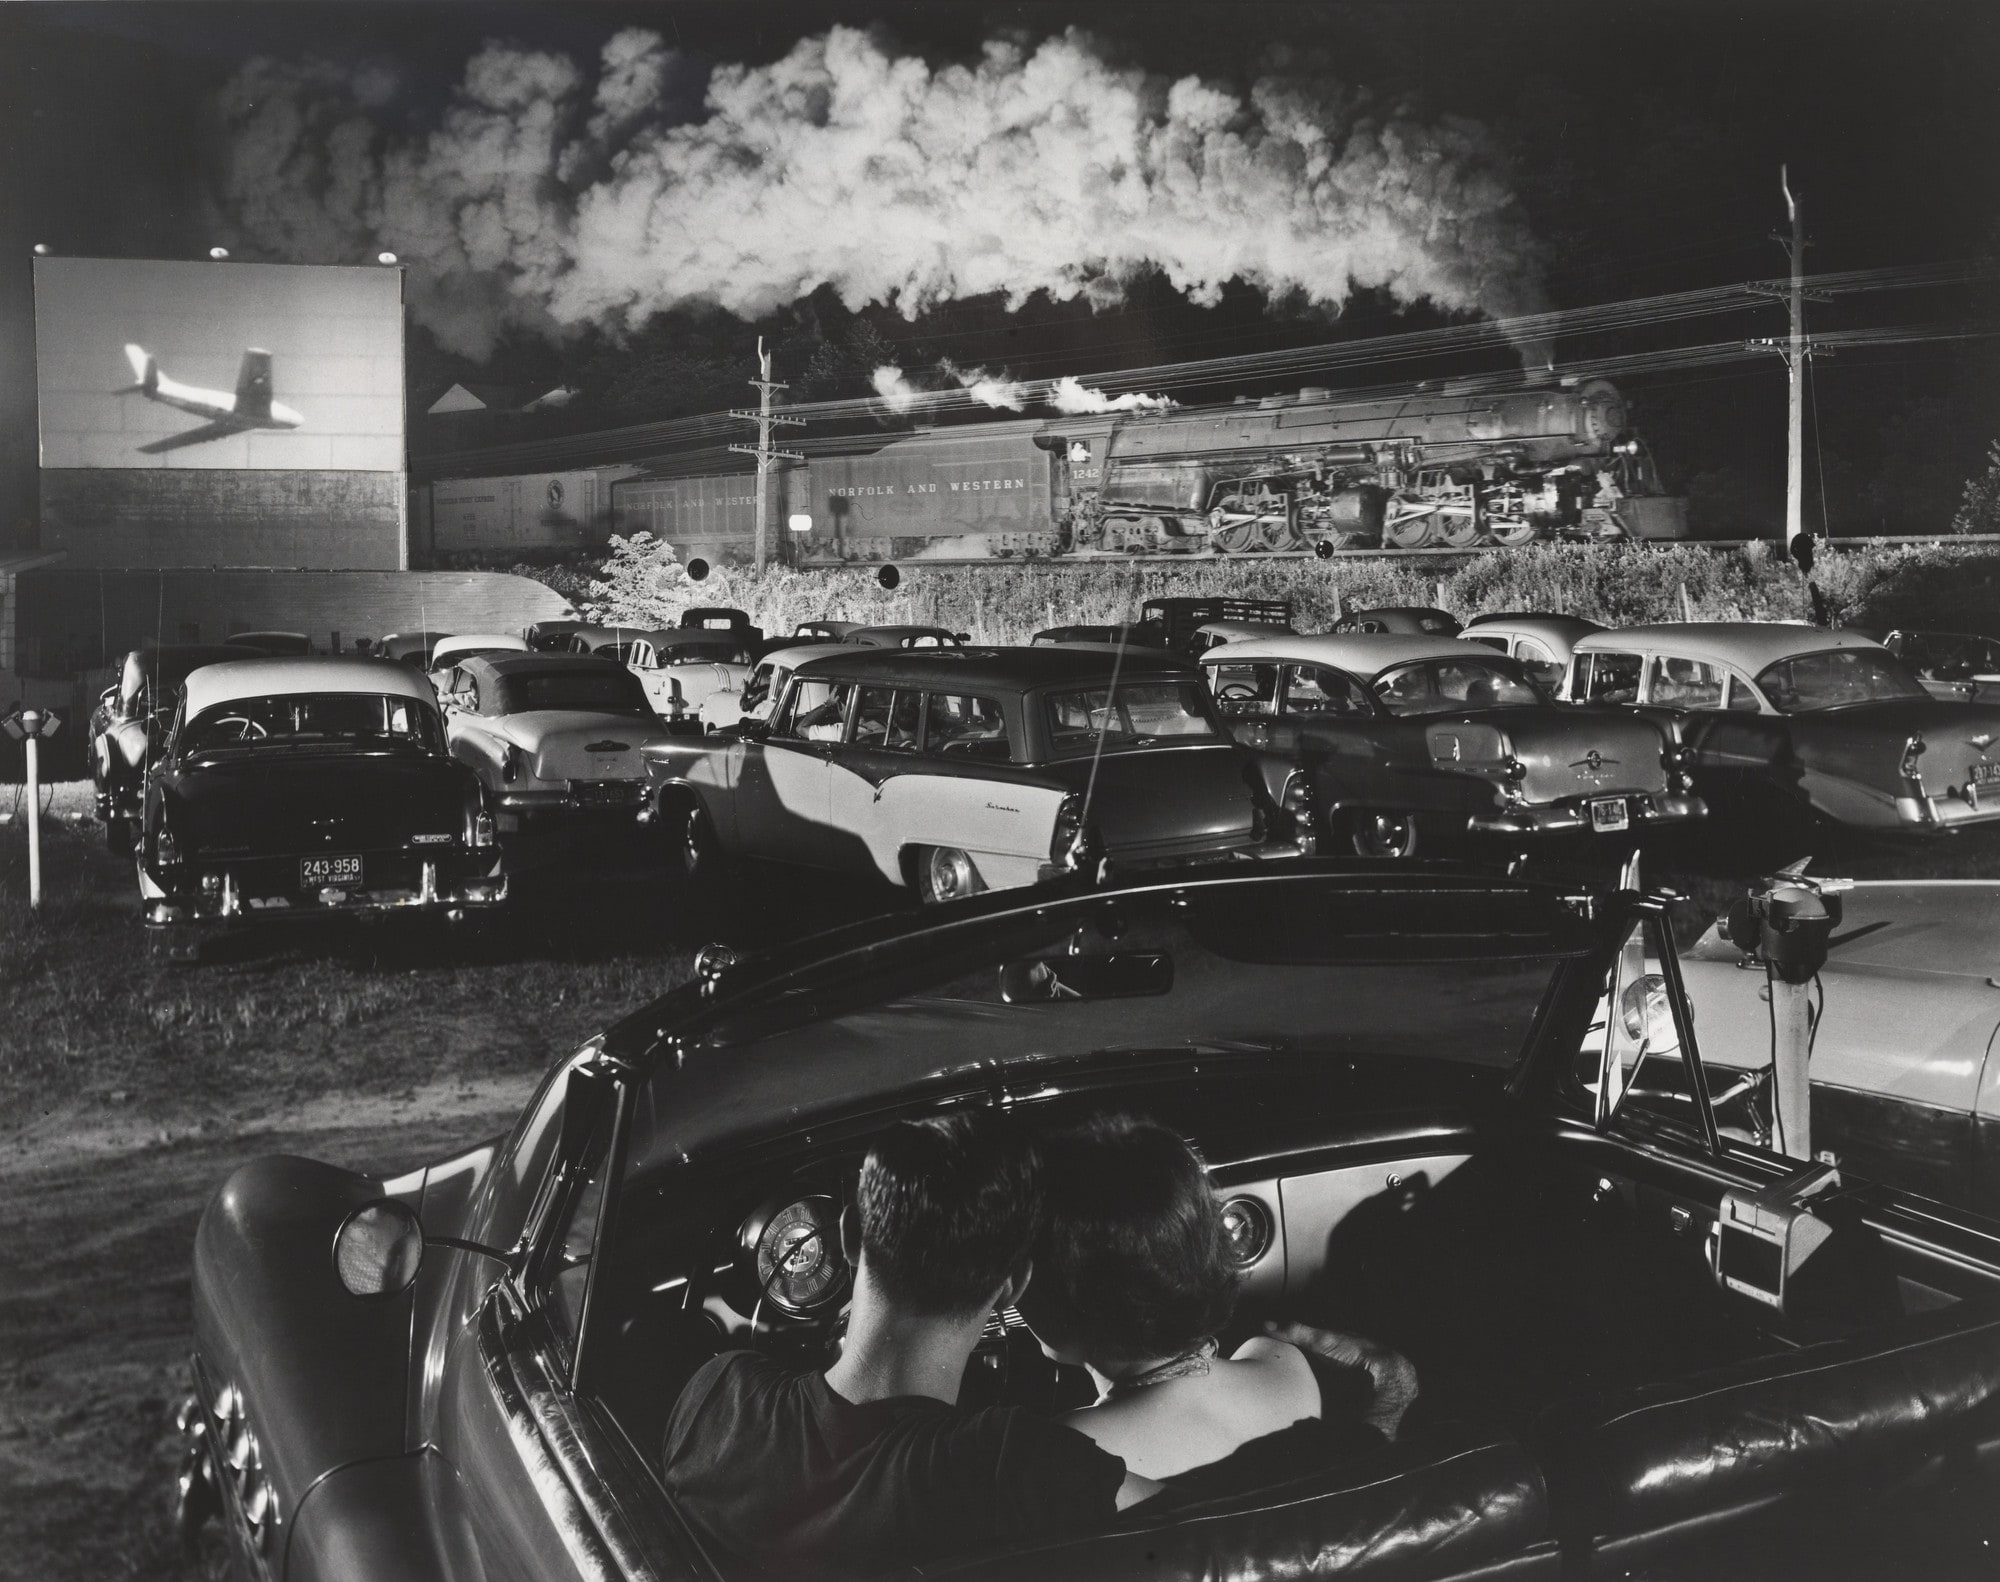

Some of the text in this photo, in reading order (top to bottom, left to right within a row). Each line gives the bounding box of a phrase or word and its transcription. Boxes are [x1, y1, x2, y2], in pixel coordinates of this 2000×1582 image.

[1073, 468, 1099, 479] 1242
[829, 478, 1025, 497] NORFOLK AND WESTERN
[683, 498, 705, 508] AND
[715, 495, 758, 506] WESTER
[304, 858, 360, 875] 243-958
[308, 875, 325, 884] WEST
[328, 873, 354, 882] VIRGINIA
